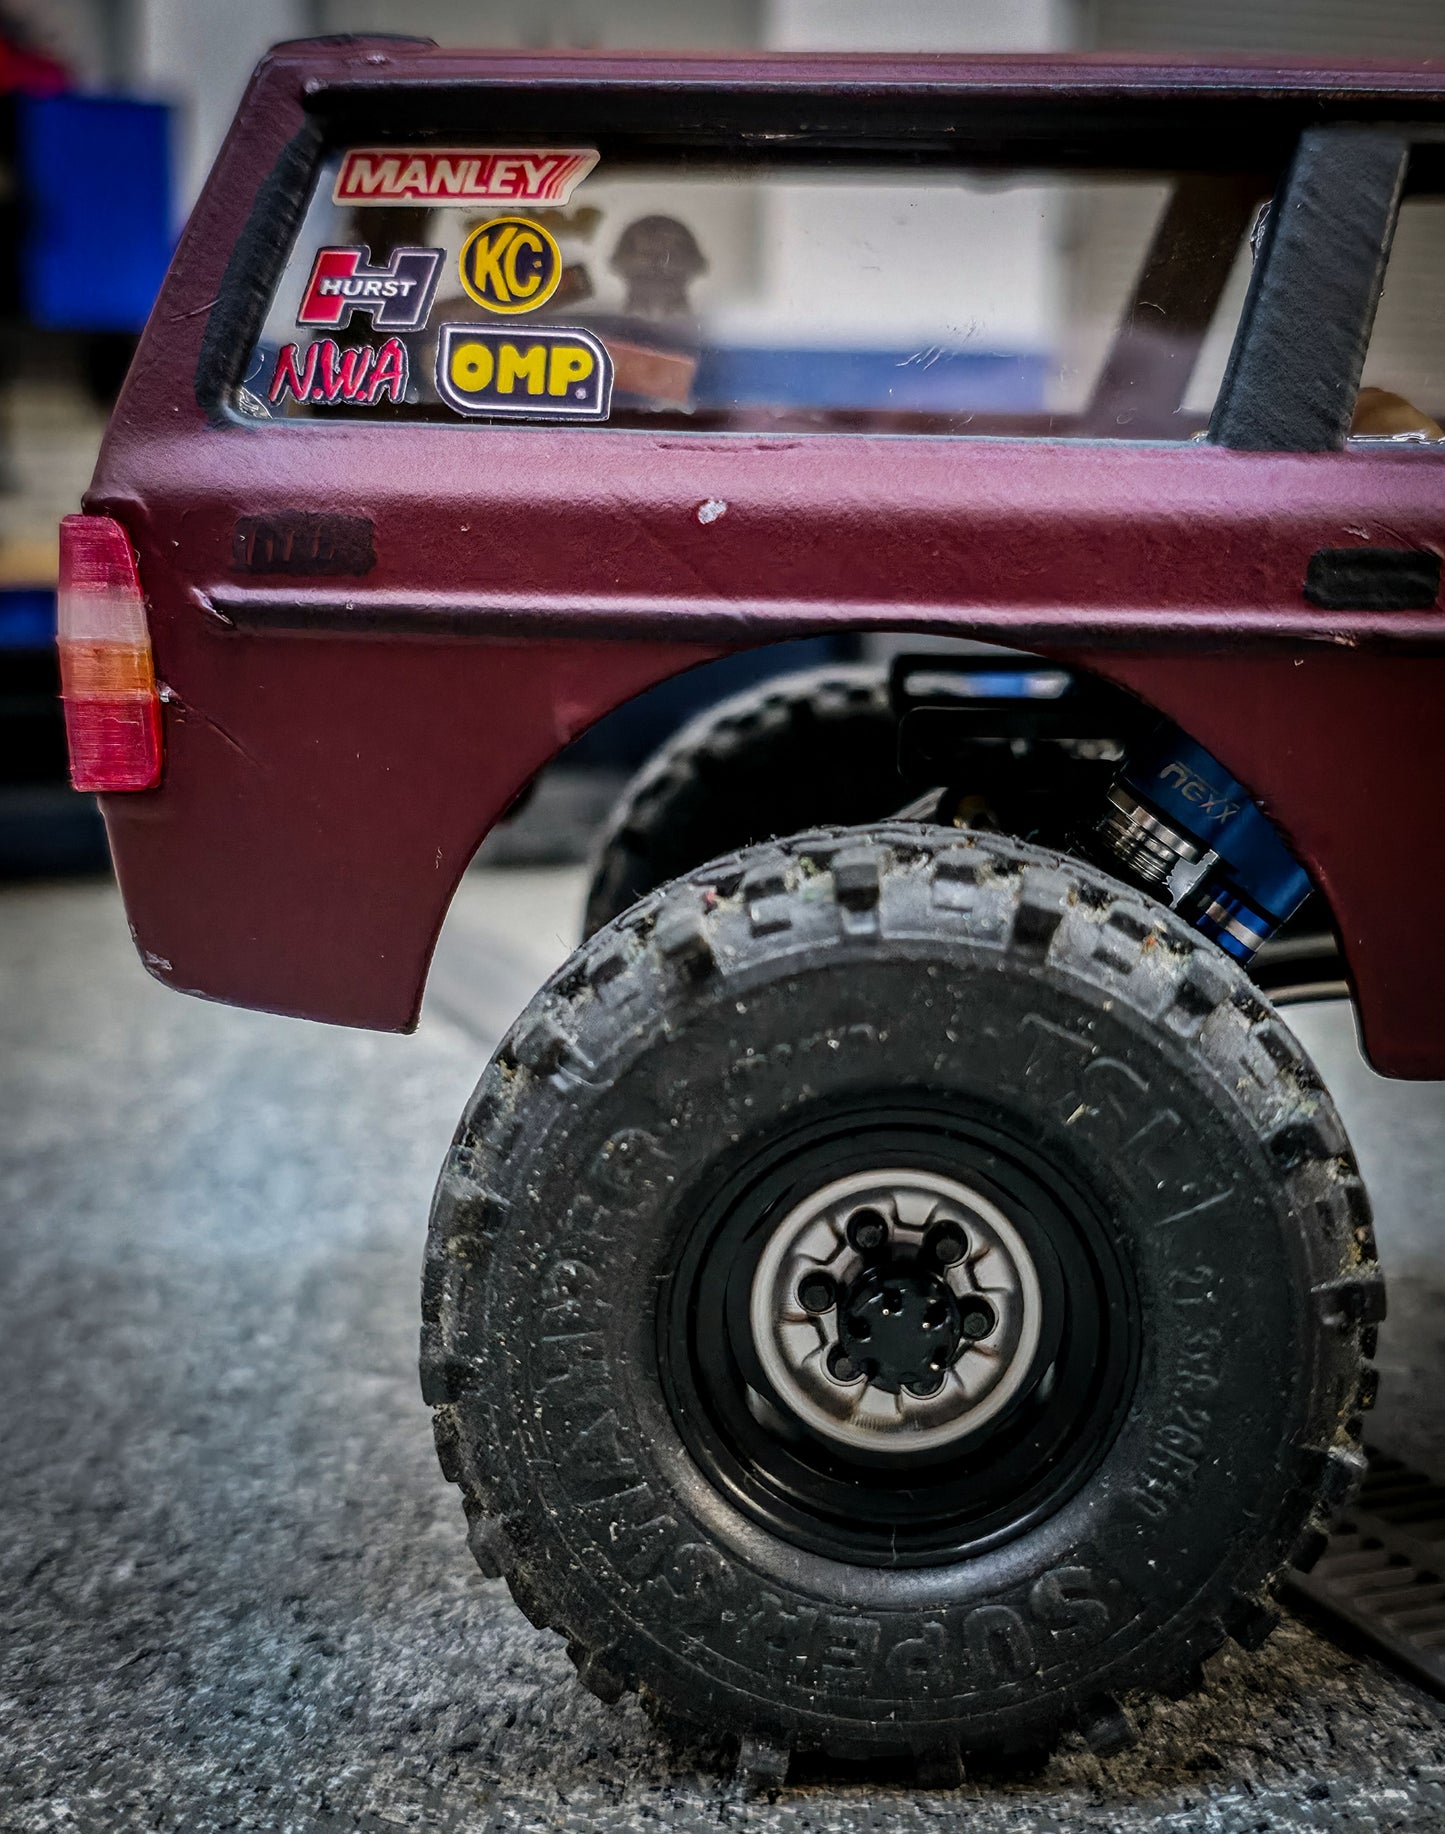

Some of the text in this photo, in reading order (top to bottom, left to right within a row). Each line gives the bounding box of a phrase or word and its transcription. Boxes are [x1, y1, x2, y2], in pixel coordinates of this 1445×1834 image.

[345, 158, 554, 194] MANLEY
[320, 278, 417, 297] HURST
[474, 227, 543, 302] KC
[740, 1563, 1111, 1691] SUPER
